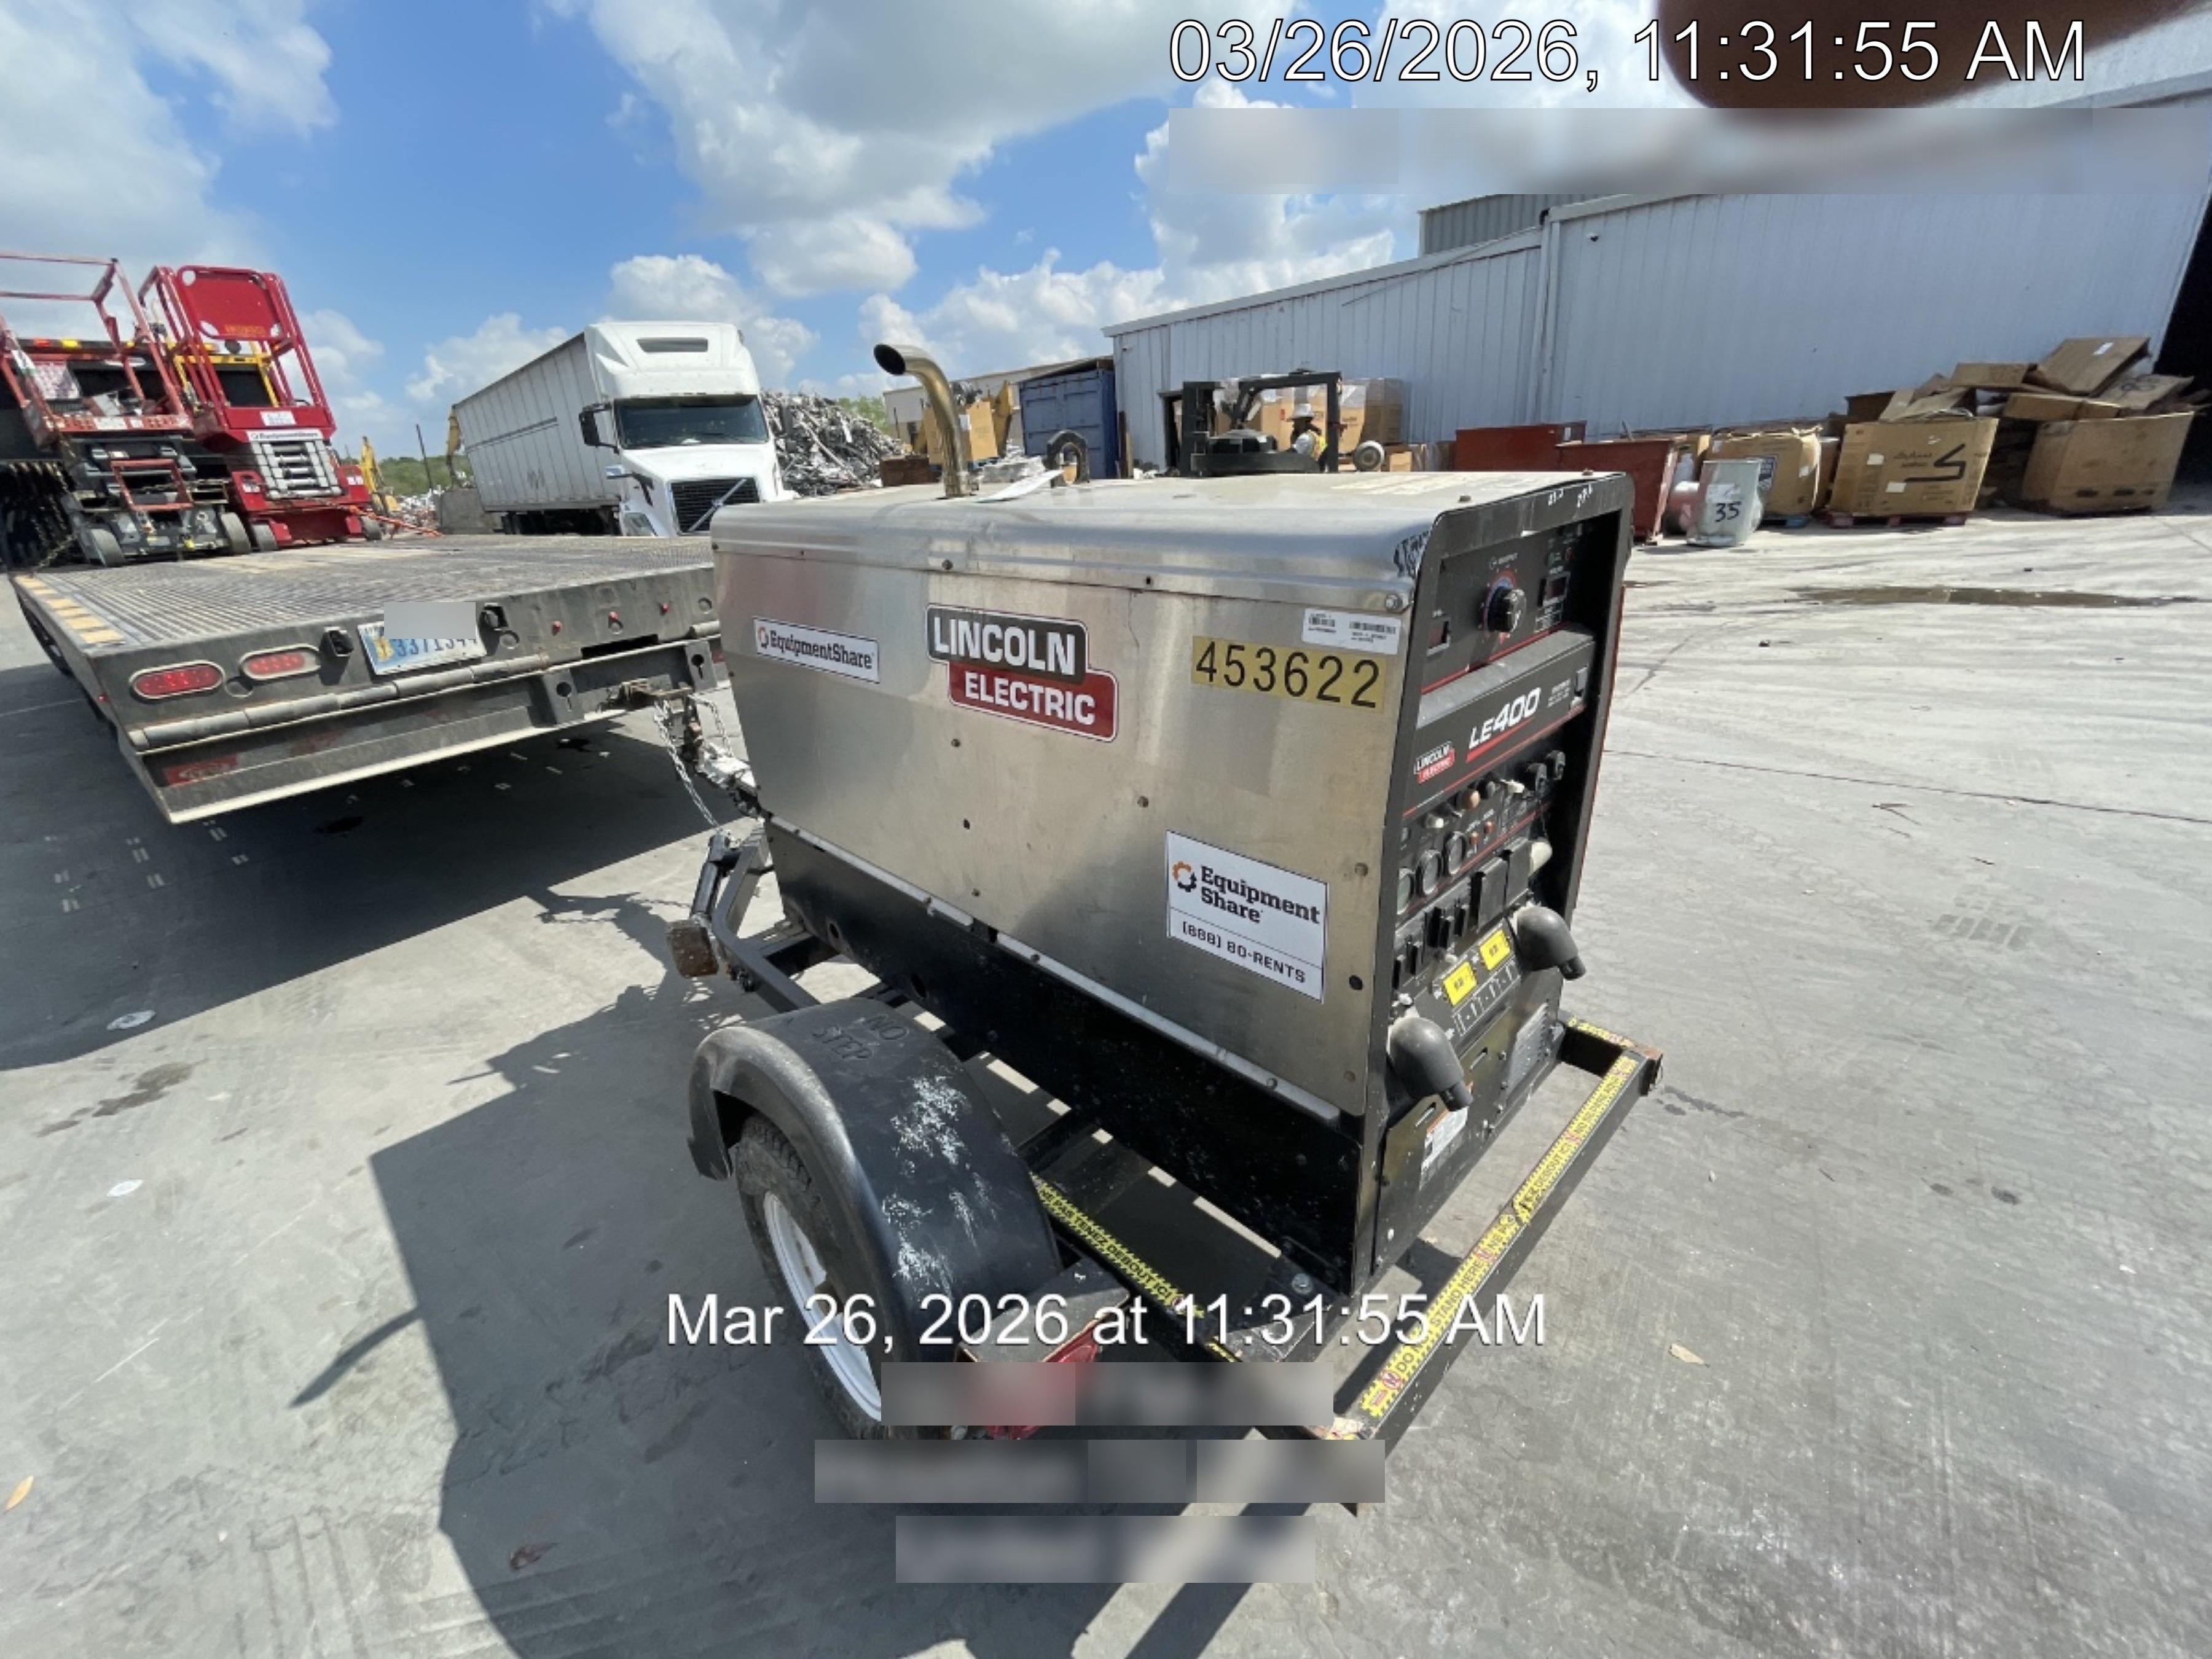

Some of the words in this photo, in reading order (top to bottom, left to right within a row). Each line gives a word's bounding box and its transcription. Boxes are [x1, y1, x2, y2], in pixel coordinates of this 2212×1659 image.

[1716, 501, 1741, 522] 35
[770, 630, 873, 670] EquipmentShare
[933, 616, 1076, 676] LINCOLN
[1196, 641, 1379, 708] 453622
[965, 670, 1096, 726] ELECTRIC
[1468, 687, 1542, 750] LE400
[1416, 743, 1450, 772] LINCOLN
[1201, 865, 1320, 924] Equipment
[1201, 887, 1260, 924] Share
[1226, 940, 1306, 983] 80-RENTS
[812, 1024, 873, 1059] STEP
[861, 1014, 909, 1040] NO
[1105, 1243, 1155, 1284] DEBOUT
[1395, 1352, 1415, 1372] DO
